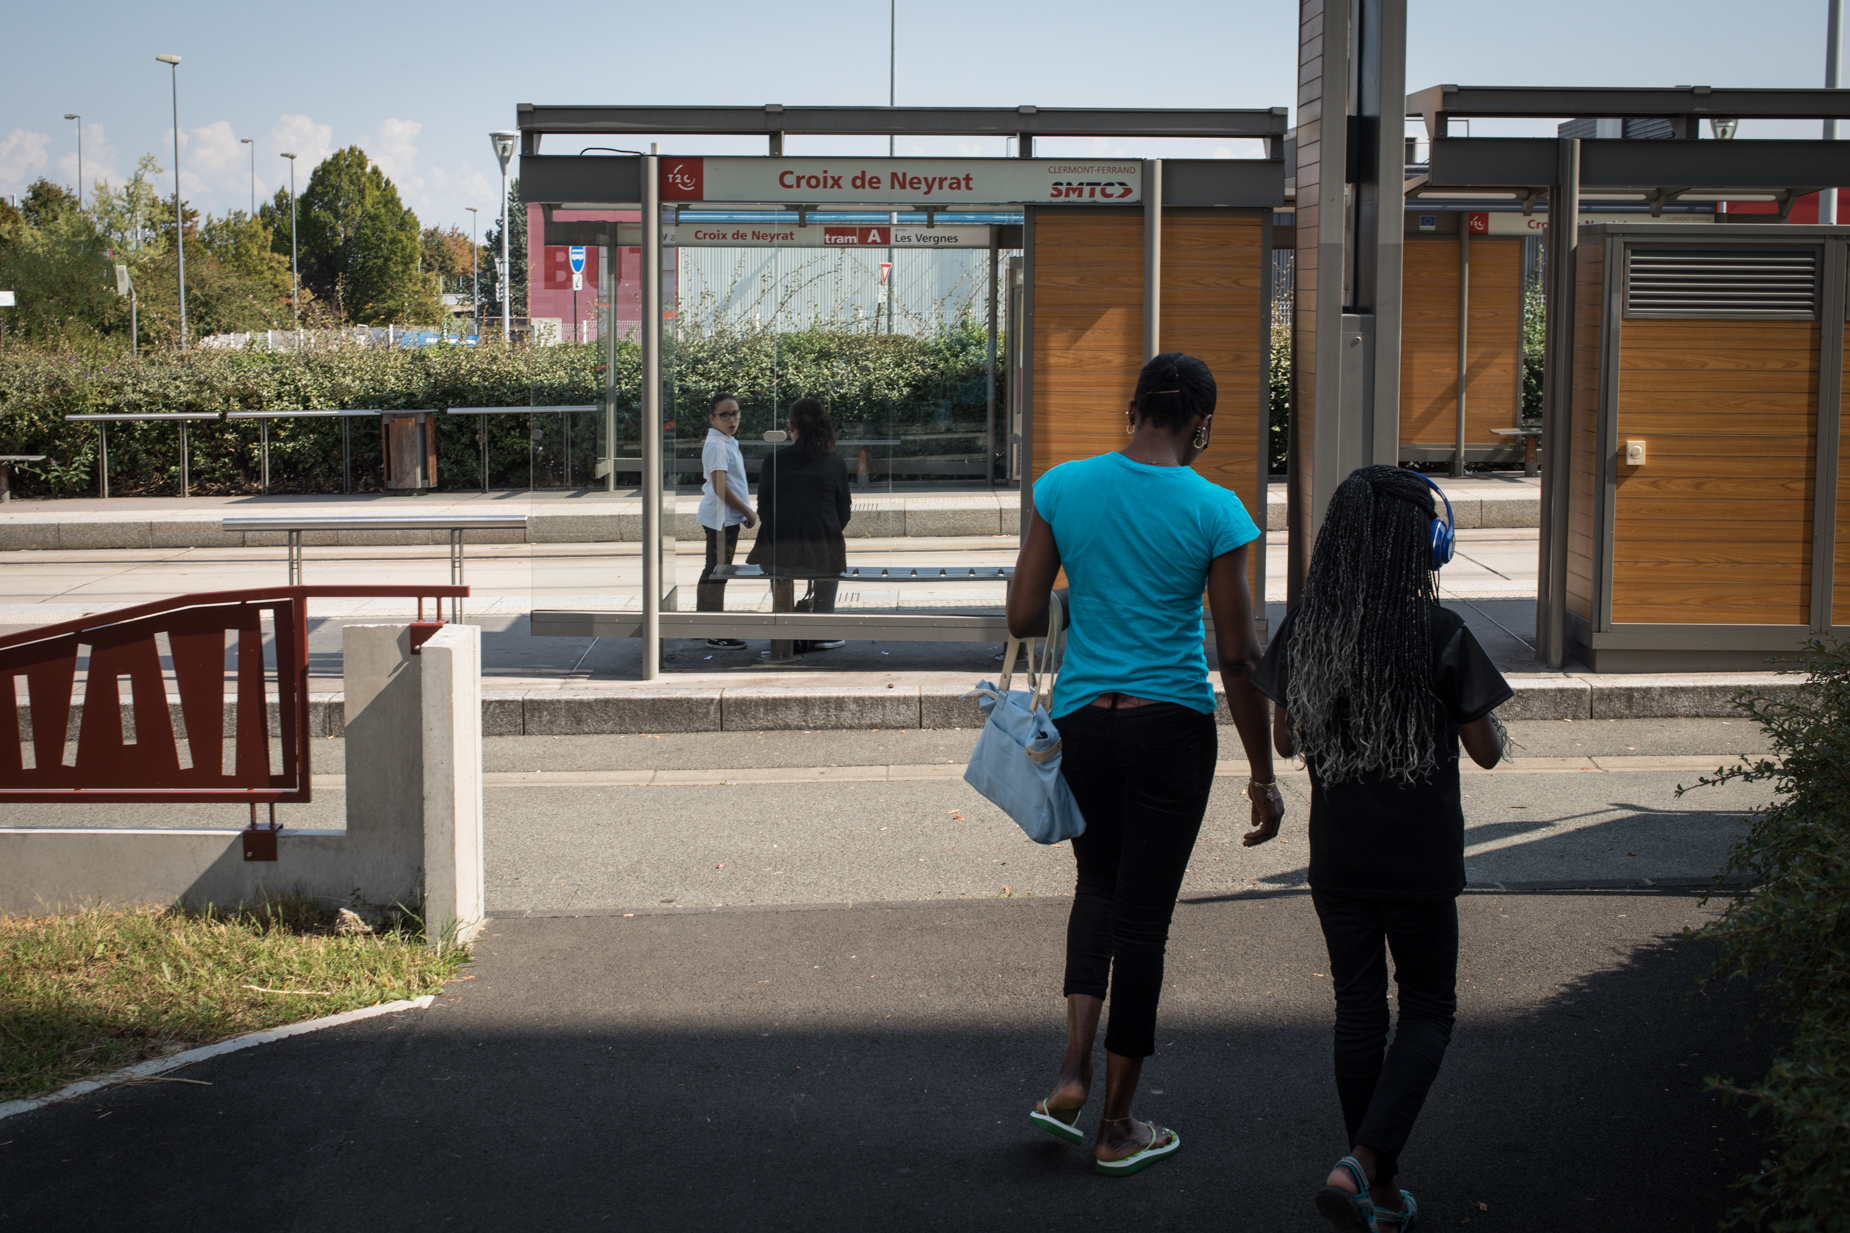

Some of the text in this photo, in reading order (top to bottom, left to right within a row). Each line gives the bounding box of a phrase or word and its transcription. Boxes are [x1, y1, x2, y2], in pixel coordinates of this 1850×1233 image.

[1047, 166, 1136, 175] CLERMONT-FERRAND
[778, 170, 973, 195] Croix de Neyrat
[1050, 181, 1120, 198] SMTC
[694, 229, 795, 243] Croix de Neyrat
[824, 229, 882, 244] tram A
[894, 233, 959, 245] Les Vergnes
